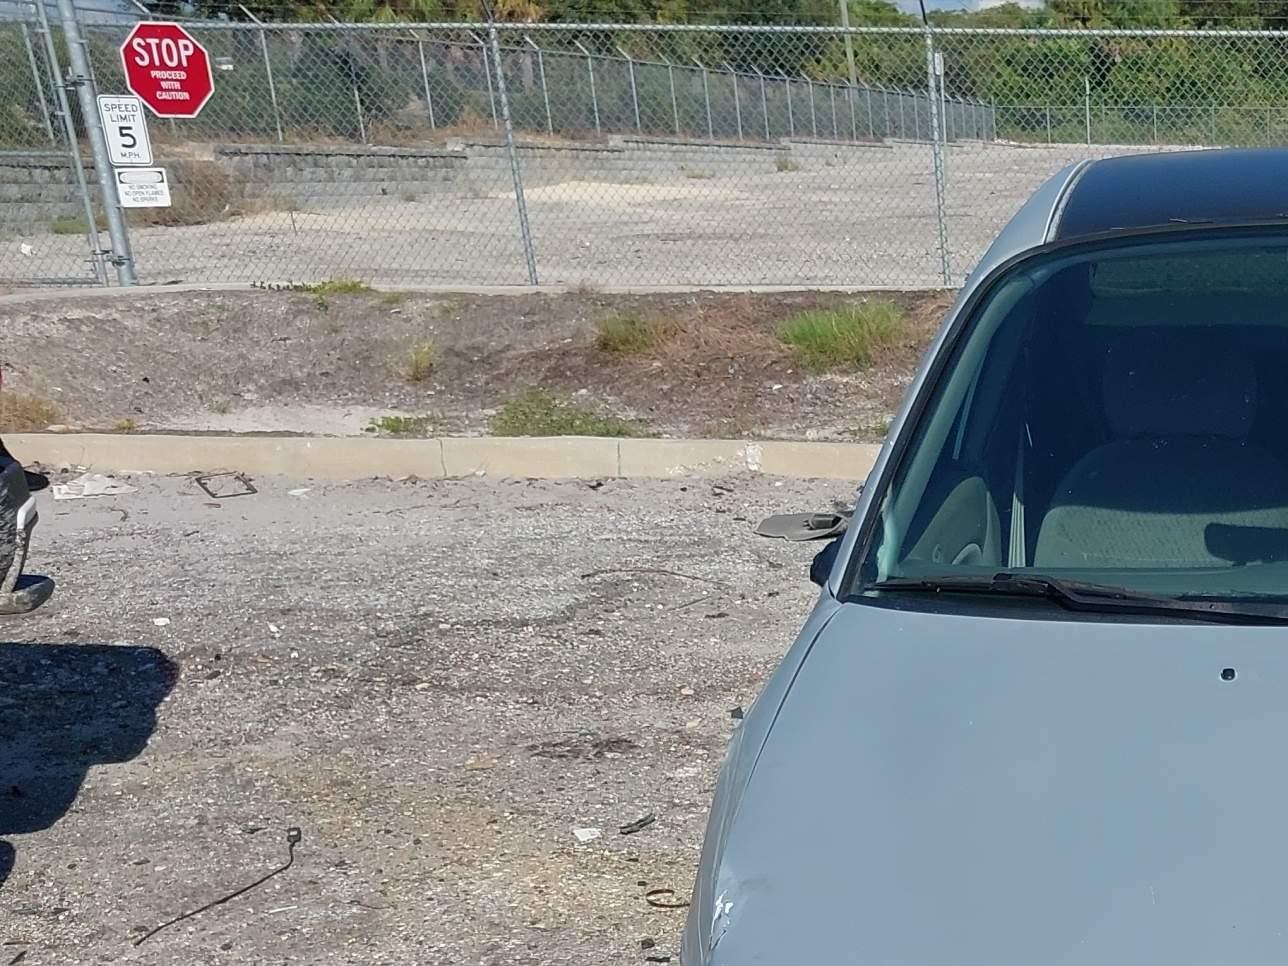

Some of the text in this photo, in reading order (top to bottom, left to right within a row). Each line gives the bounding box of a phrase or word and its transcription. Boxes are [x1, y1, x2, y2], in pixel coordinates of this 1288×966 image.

[132, 37, 194, 68] STOP
[150, 70, 187, 80] PROCEED
[160, 80, 181, 90] WITH
[156, 90, 191, 100] CAUTION
[104, 103, 138, 113] SPEED
[110, 114, 137, 123] LIMIT
[118, 126, 137, 149] 5
